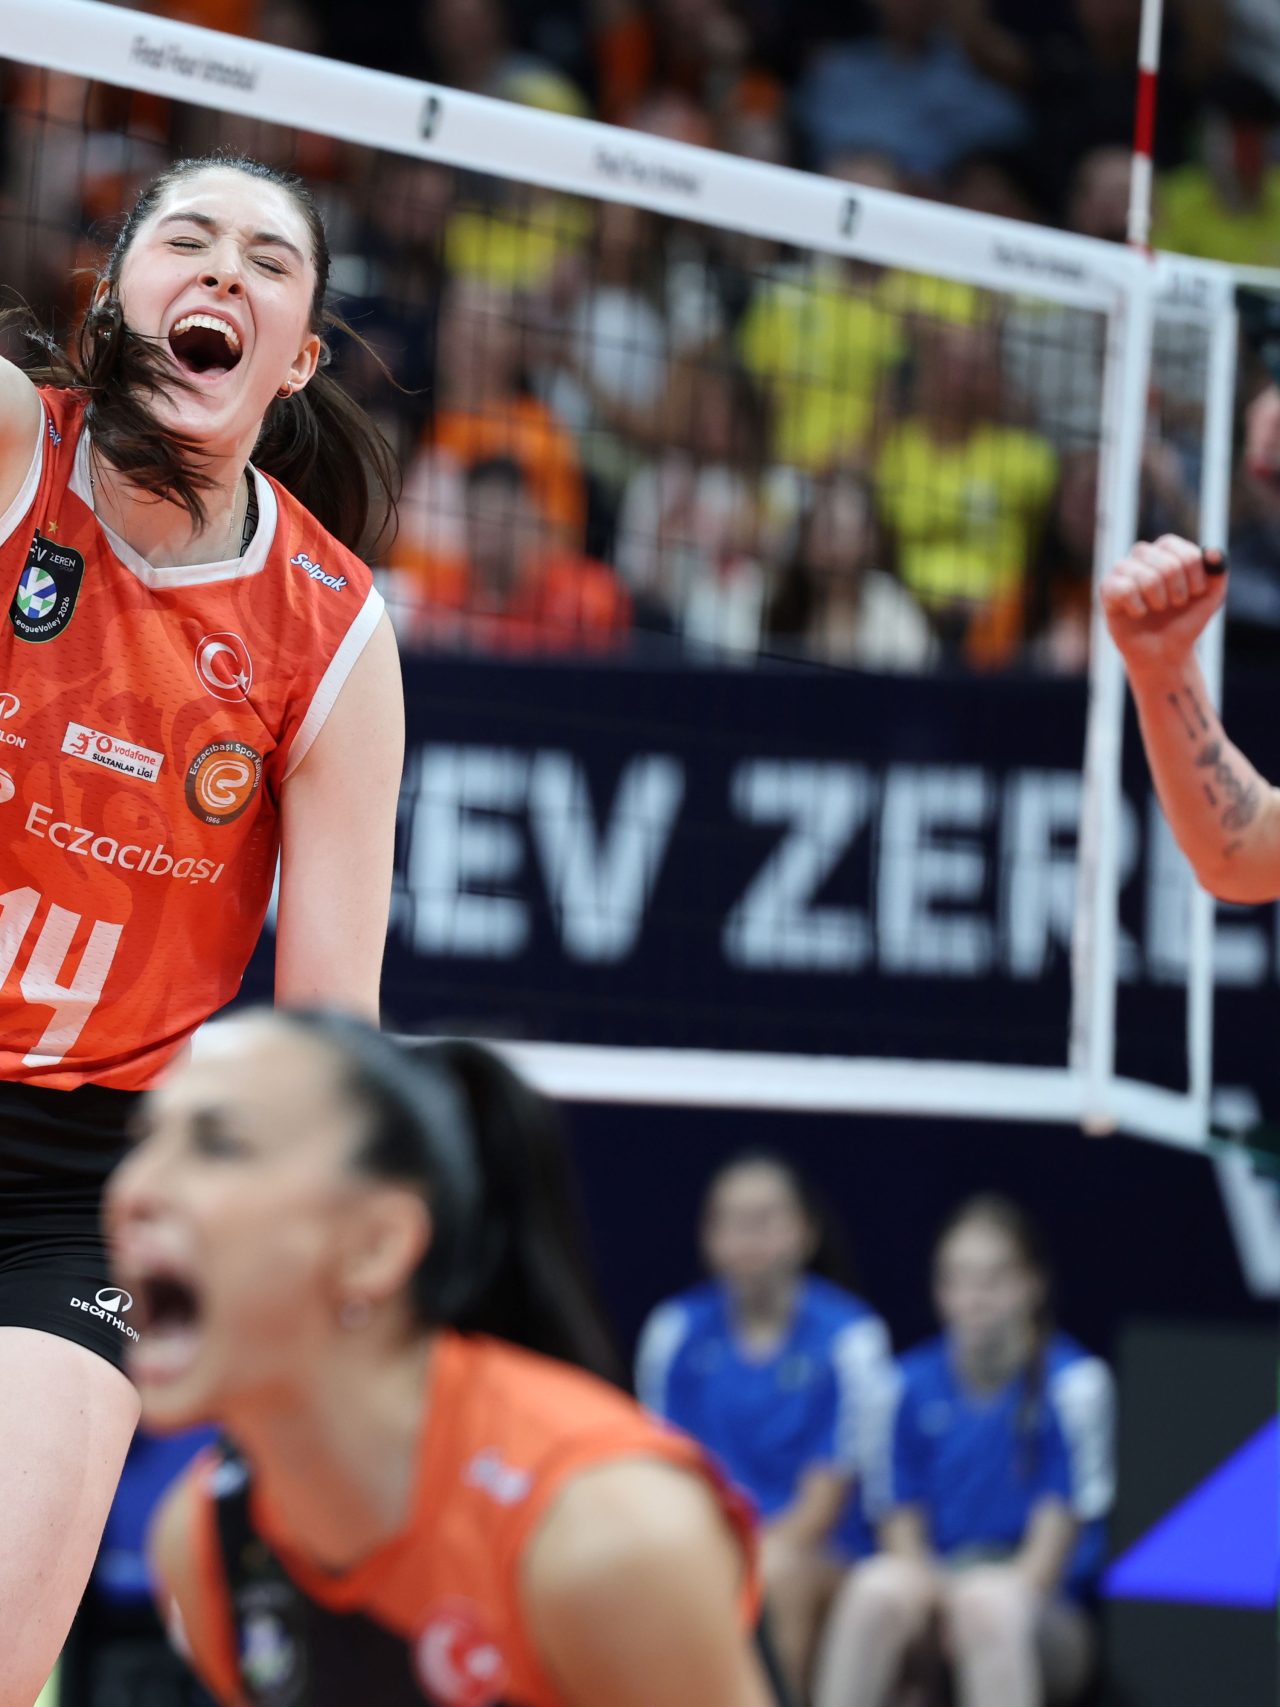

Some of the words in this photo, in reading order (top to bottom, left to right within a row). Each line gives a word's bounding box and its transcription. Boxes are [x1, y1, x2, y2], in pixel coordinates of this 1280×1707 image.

[289, 552, 348, 592] Selpak
[58, 595, 70, 618] 2026
[92, 752, 134, 774] SULTANLAR
[114, 744, 156, 765] vodafone
[235, 743, 256, 760] Spor
[24, 801, 225, 884] Eczacıbaşı
[384, 742, 686, 966] EV
[70, 1297, 140, 1343] DECATHLON
